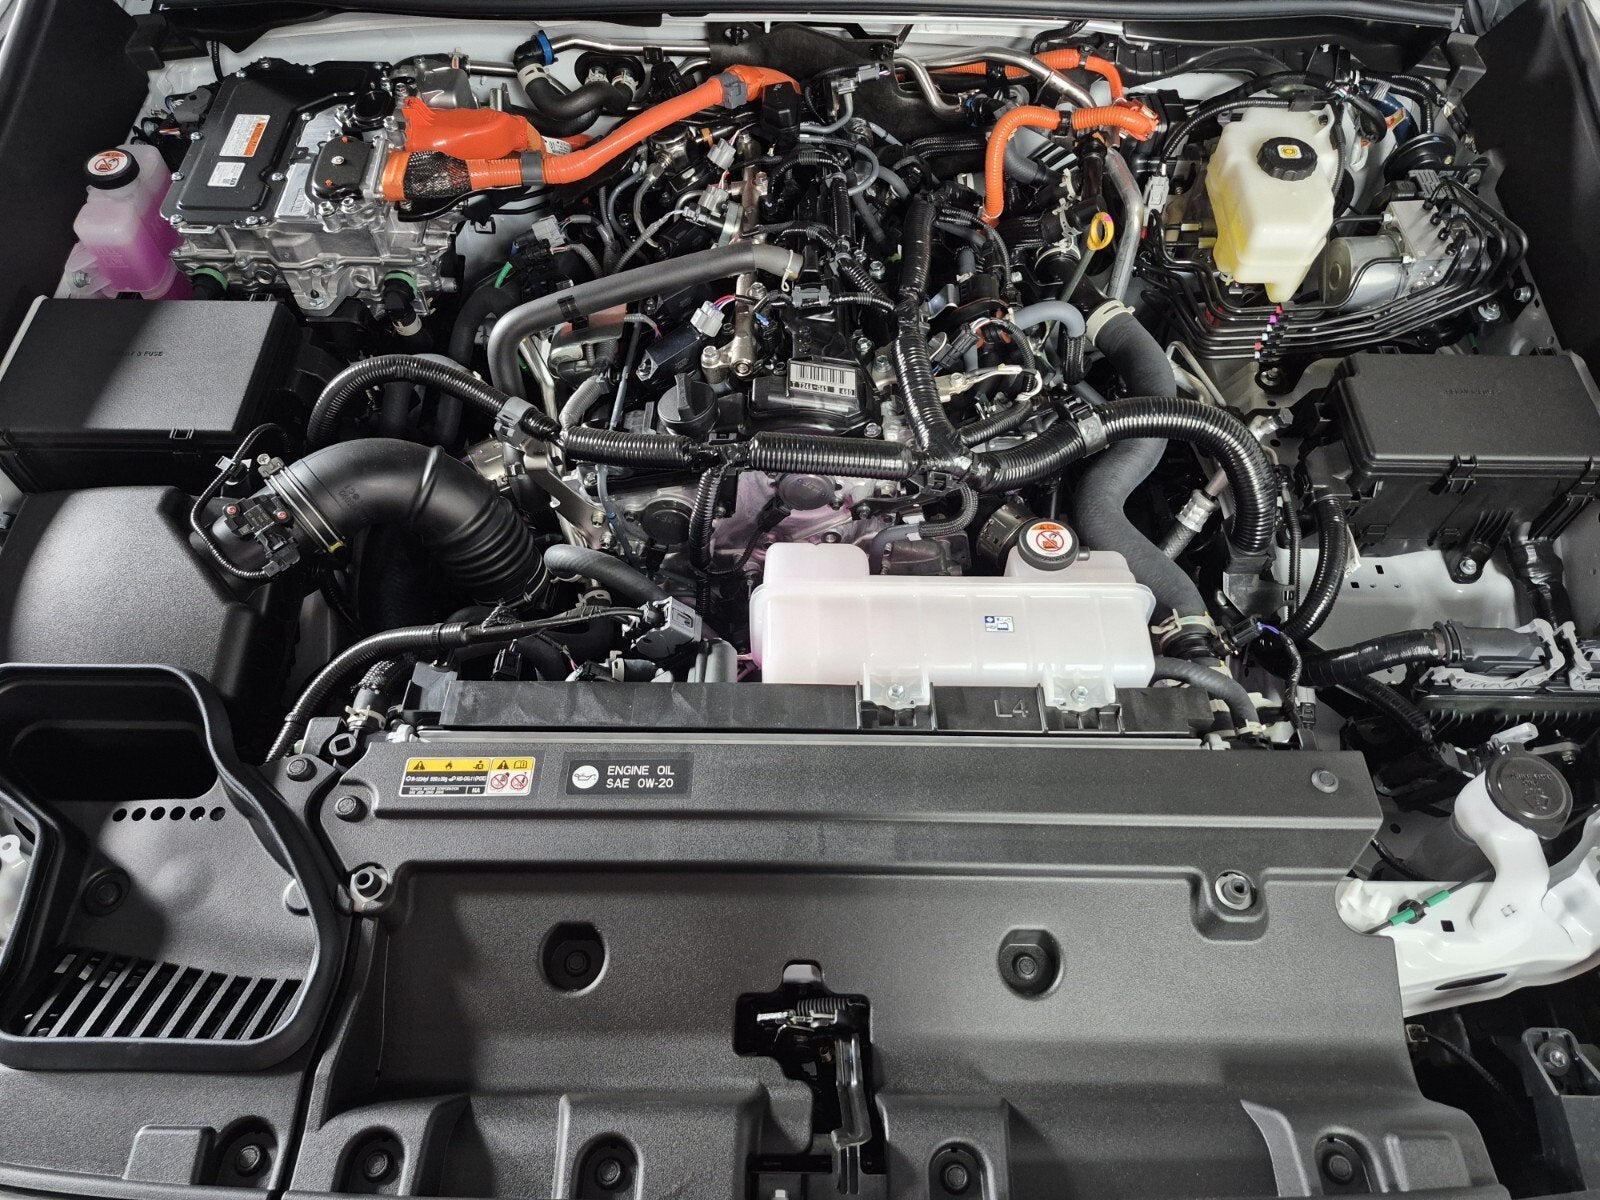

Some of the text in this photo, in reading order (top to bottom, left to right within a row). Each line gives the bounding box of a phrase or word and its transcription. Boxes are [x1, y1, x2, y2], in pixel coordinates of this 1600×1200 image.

[993, 699, 1029, 718] L4
[606, 765, 675, 776] ENGINE OIL
[605, 777, 674, 788] SAE 0W-20
